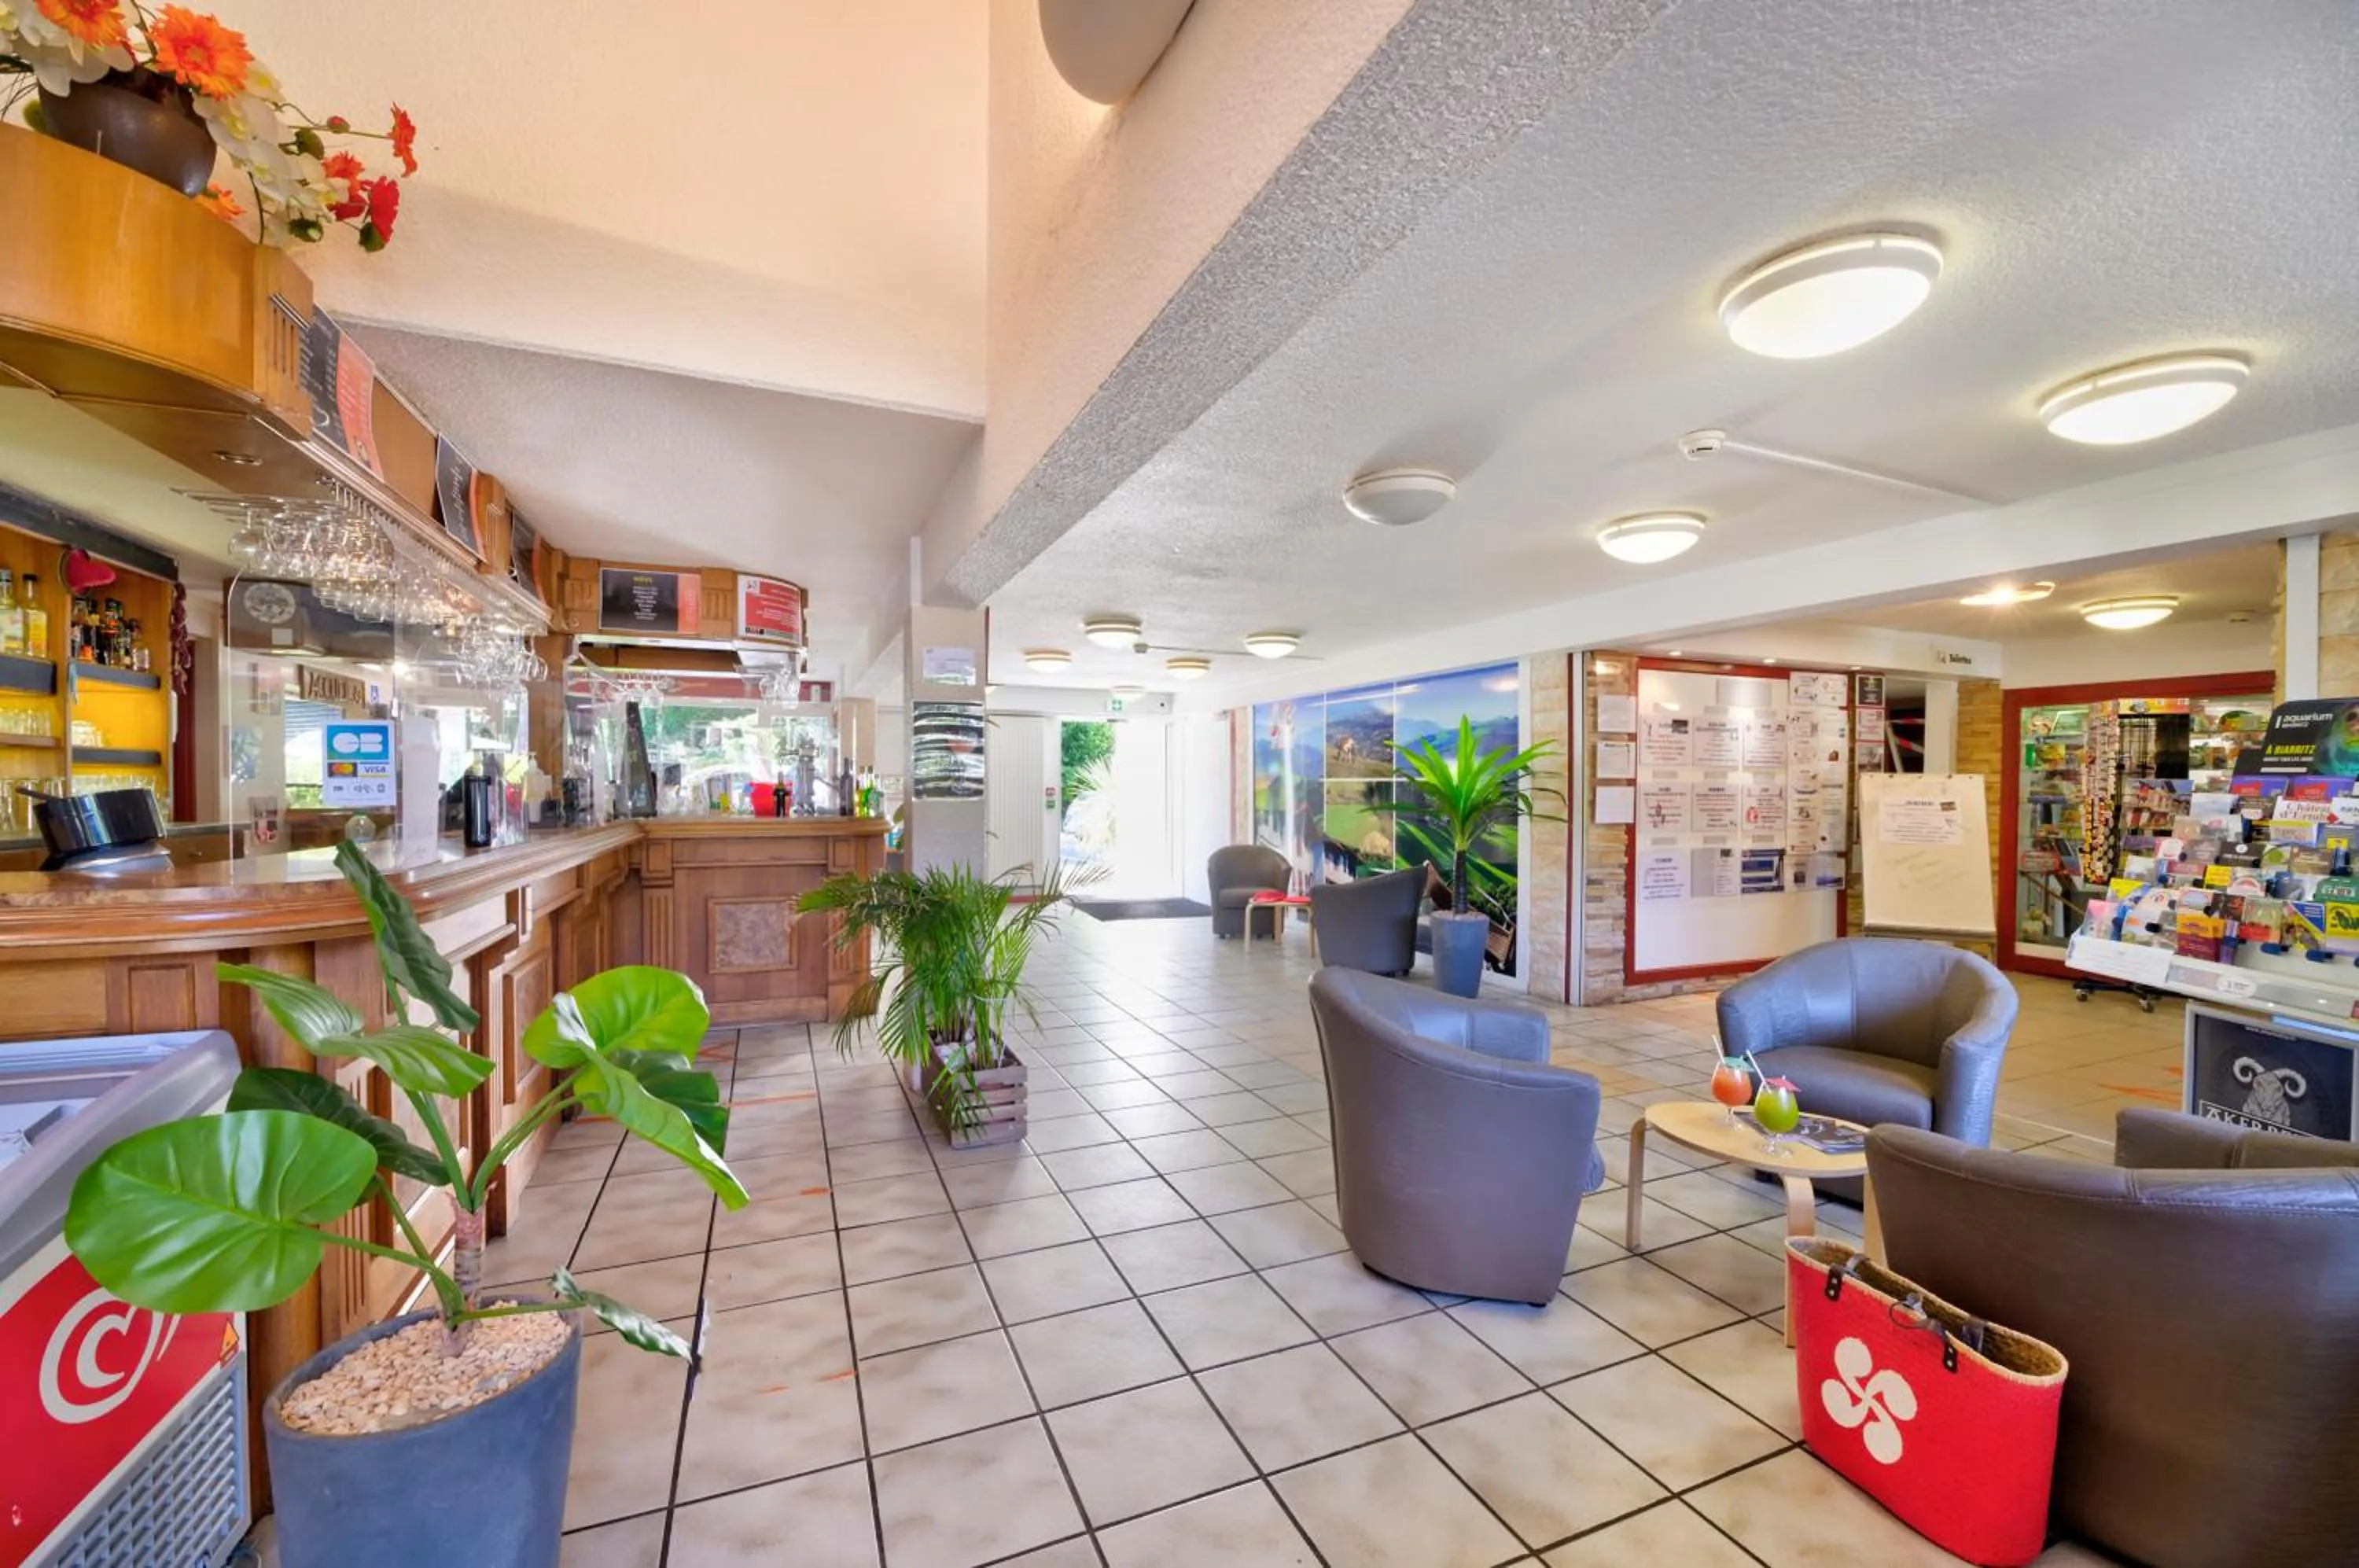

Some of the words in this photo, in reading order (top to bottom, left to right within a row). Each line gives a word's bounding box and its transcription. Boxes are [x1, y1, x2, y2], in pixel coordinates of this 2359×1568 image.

[2283, 713, 2333, 723] aquarium
[2273, 745, 2316, 755] BIARRITZ
[364, 766, 386, 775] VISA
